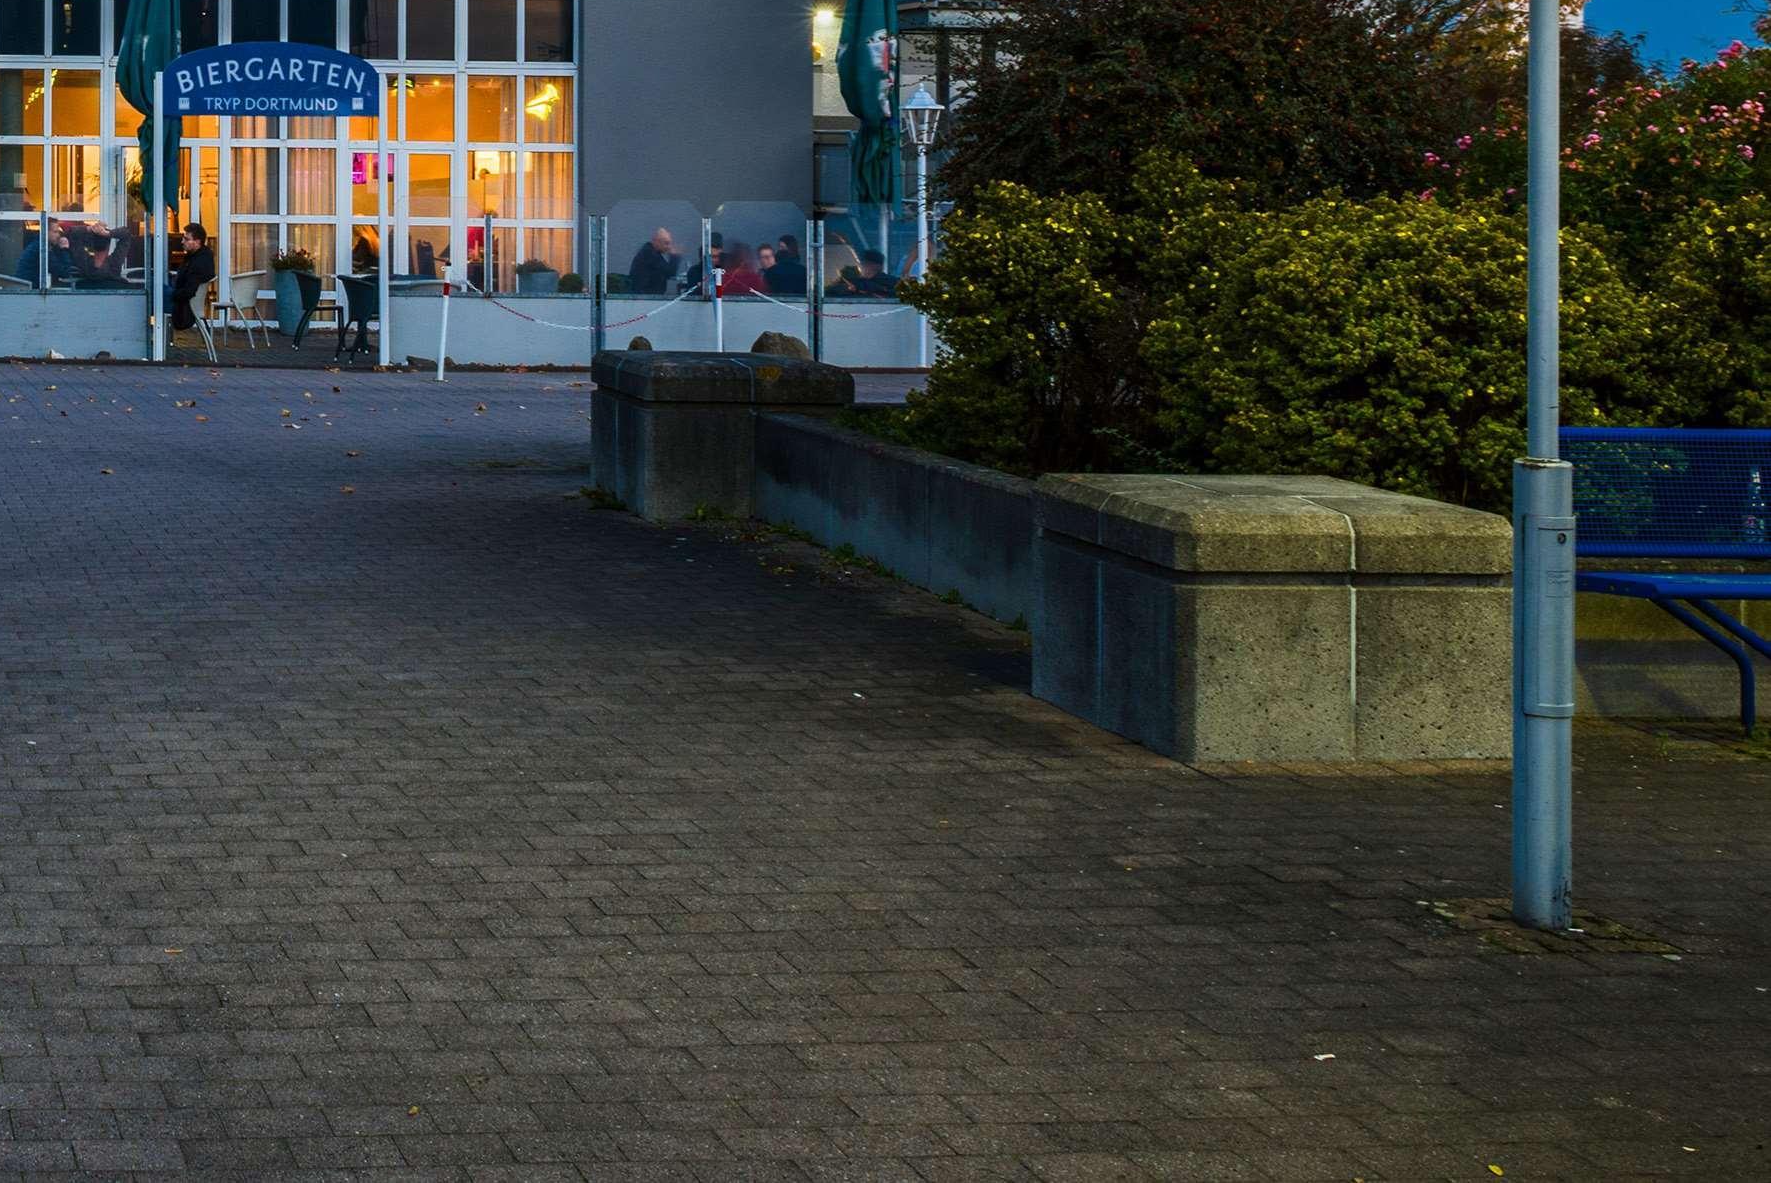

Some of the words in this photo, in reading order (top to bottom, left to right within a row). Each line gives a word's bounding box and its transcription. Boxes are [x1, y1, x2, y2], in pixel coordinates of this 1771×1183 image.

[176, 57, 366, 94] BIERGARTEN
[204, 97, 241, 111] TRYP
[245, 97, 338, 111] DORTMUND
